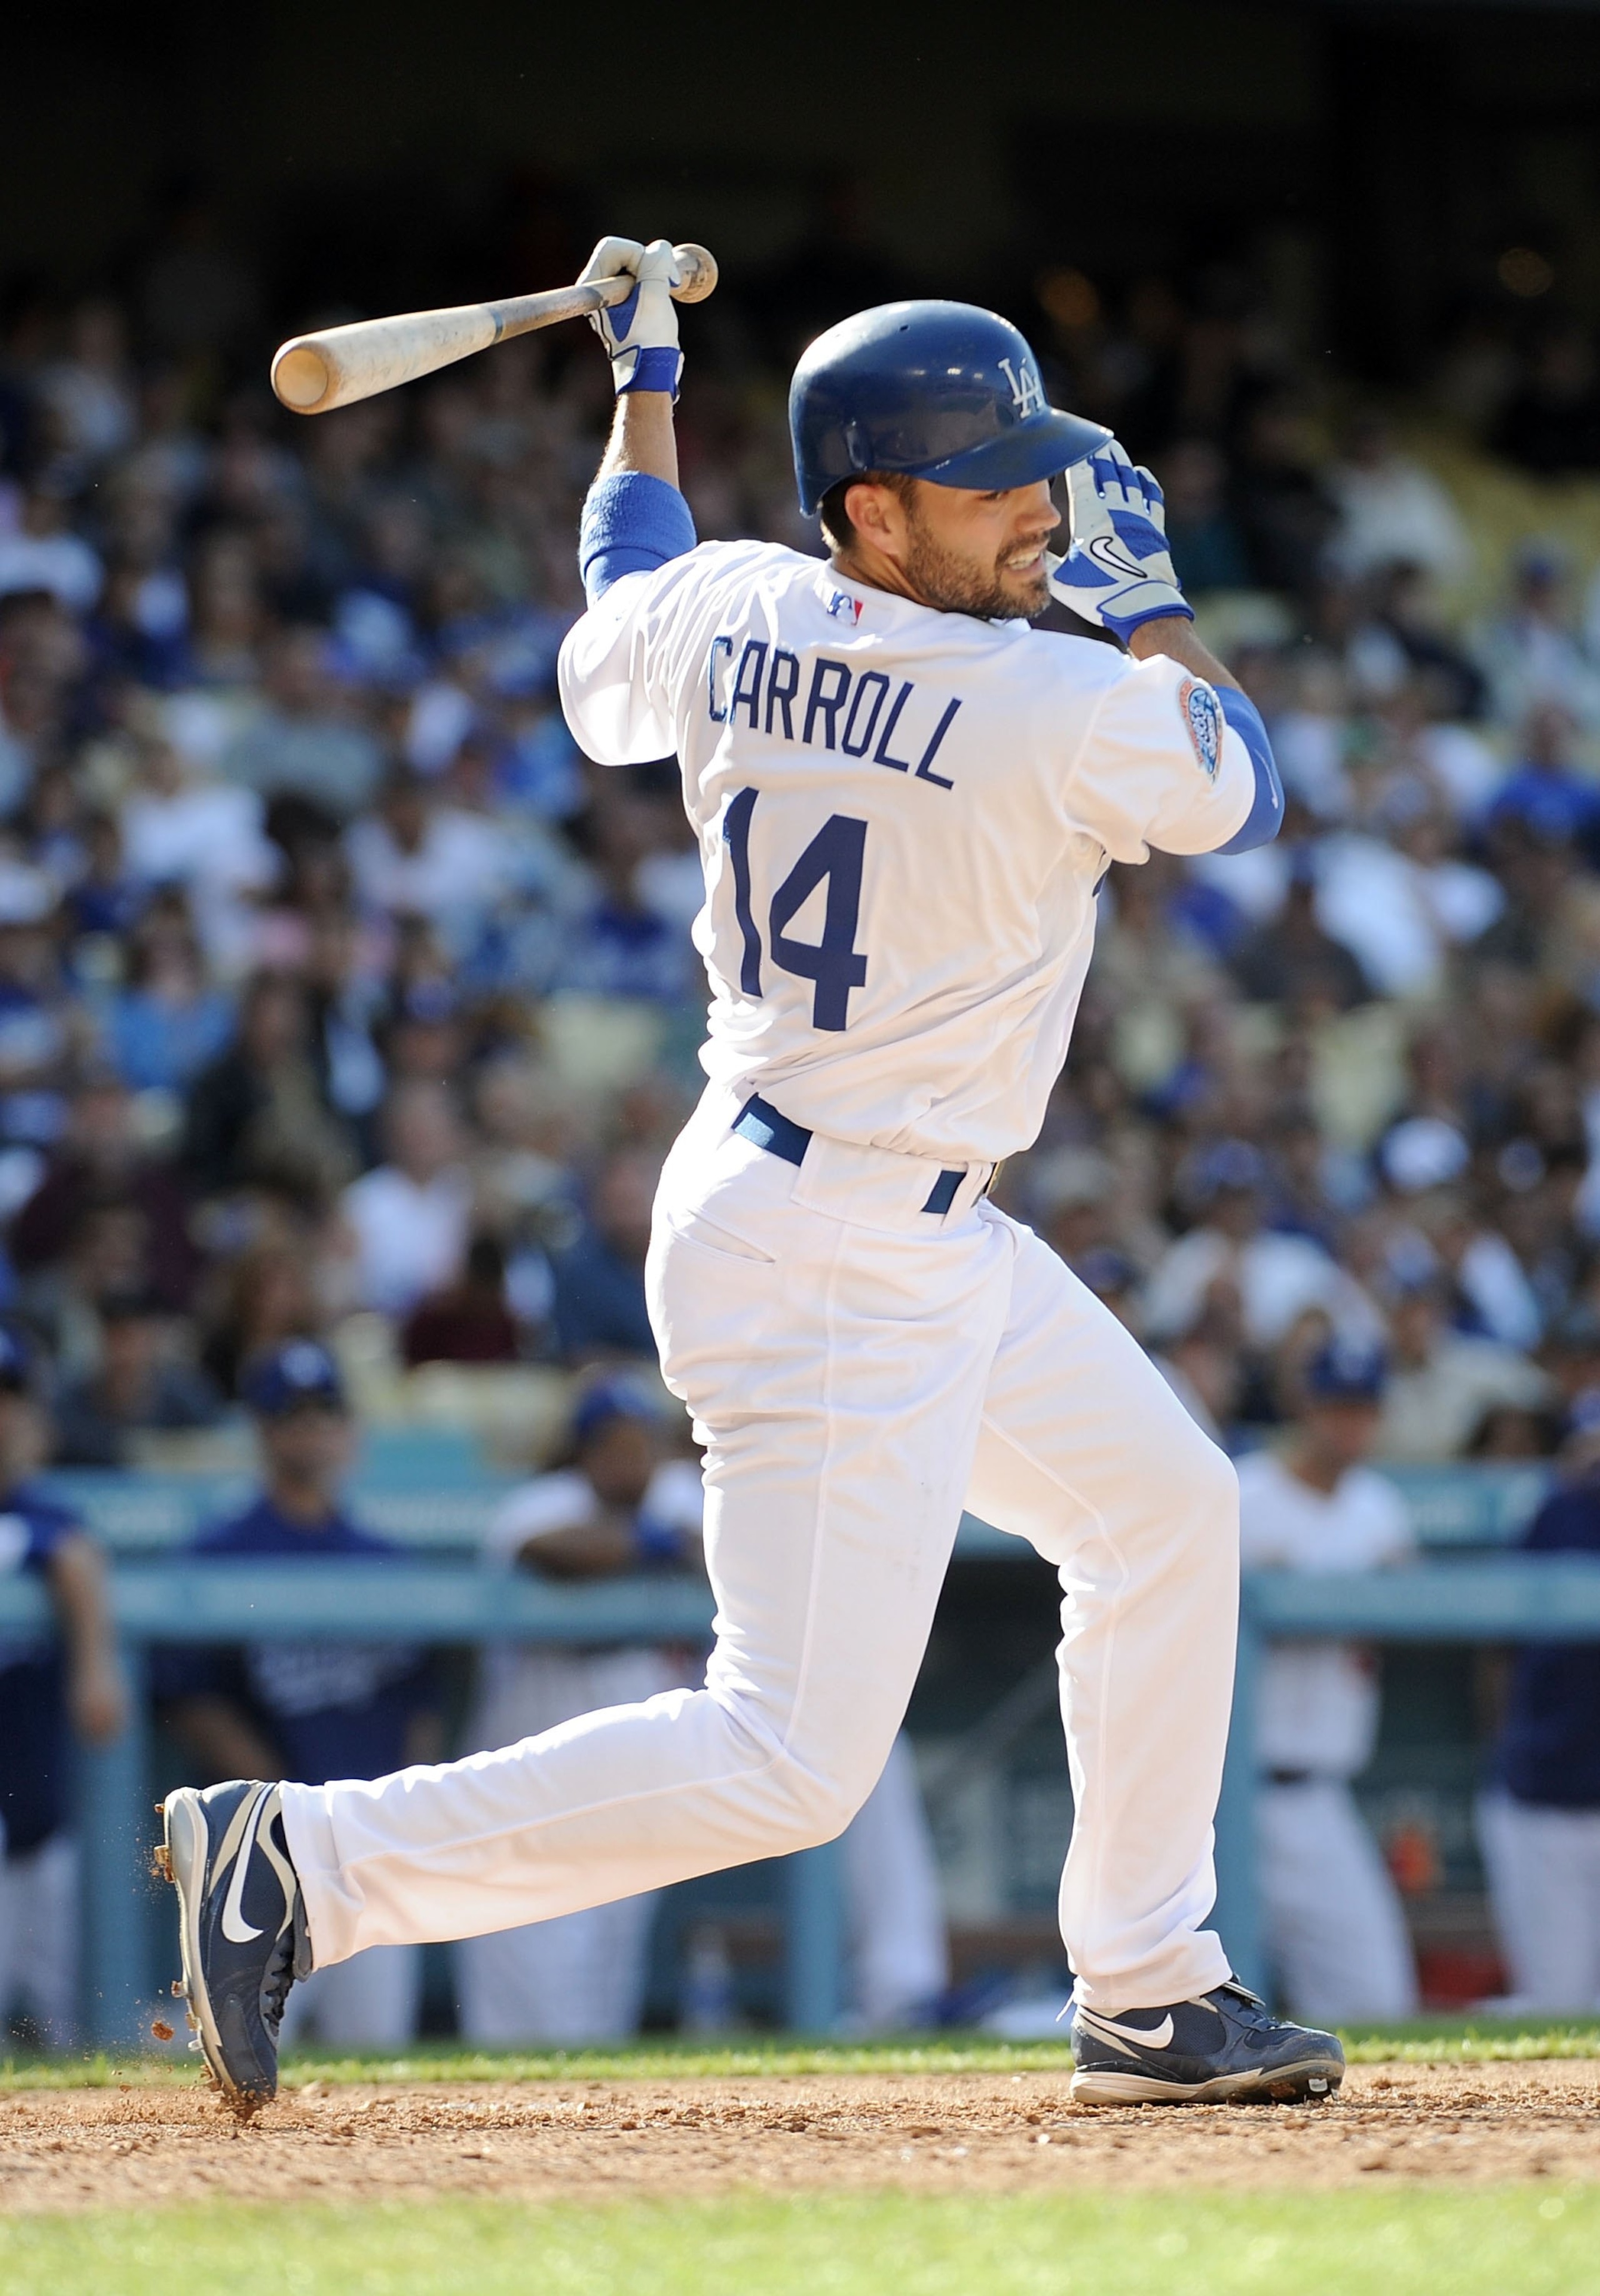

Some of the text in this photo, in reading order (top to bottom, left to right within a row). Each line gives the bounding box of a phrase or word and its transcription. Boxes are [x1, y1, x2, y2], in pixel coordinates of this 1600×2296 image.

[998, 358, 1042, 419] LA
[707, 635, 962, 790] CARROLL
[722, 786, 869, 1031] 14
